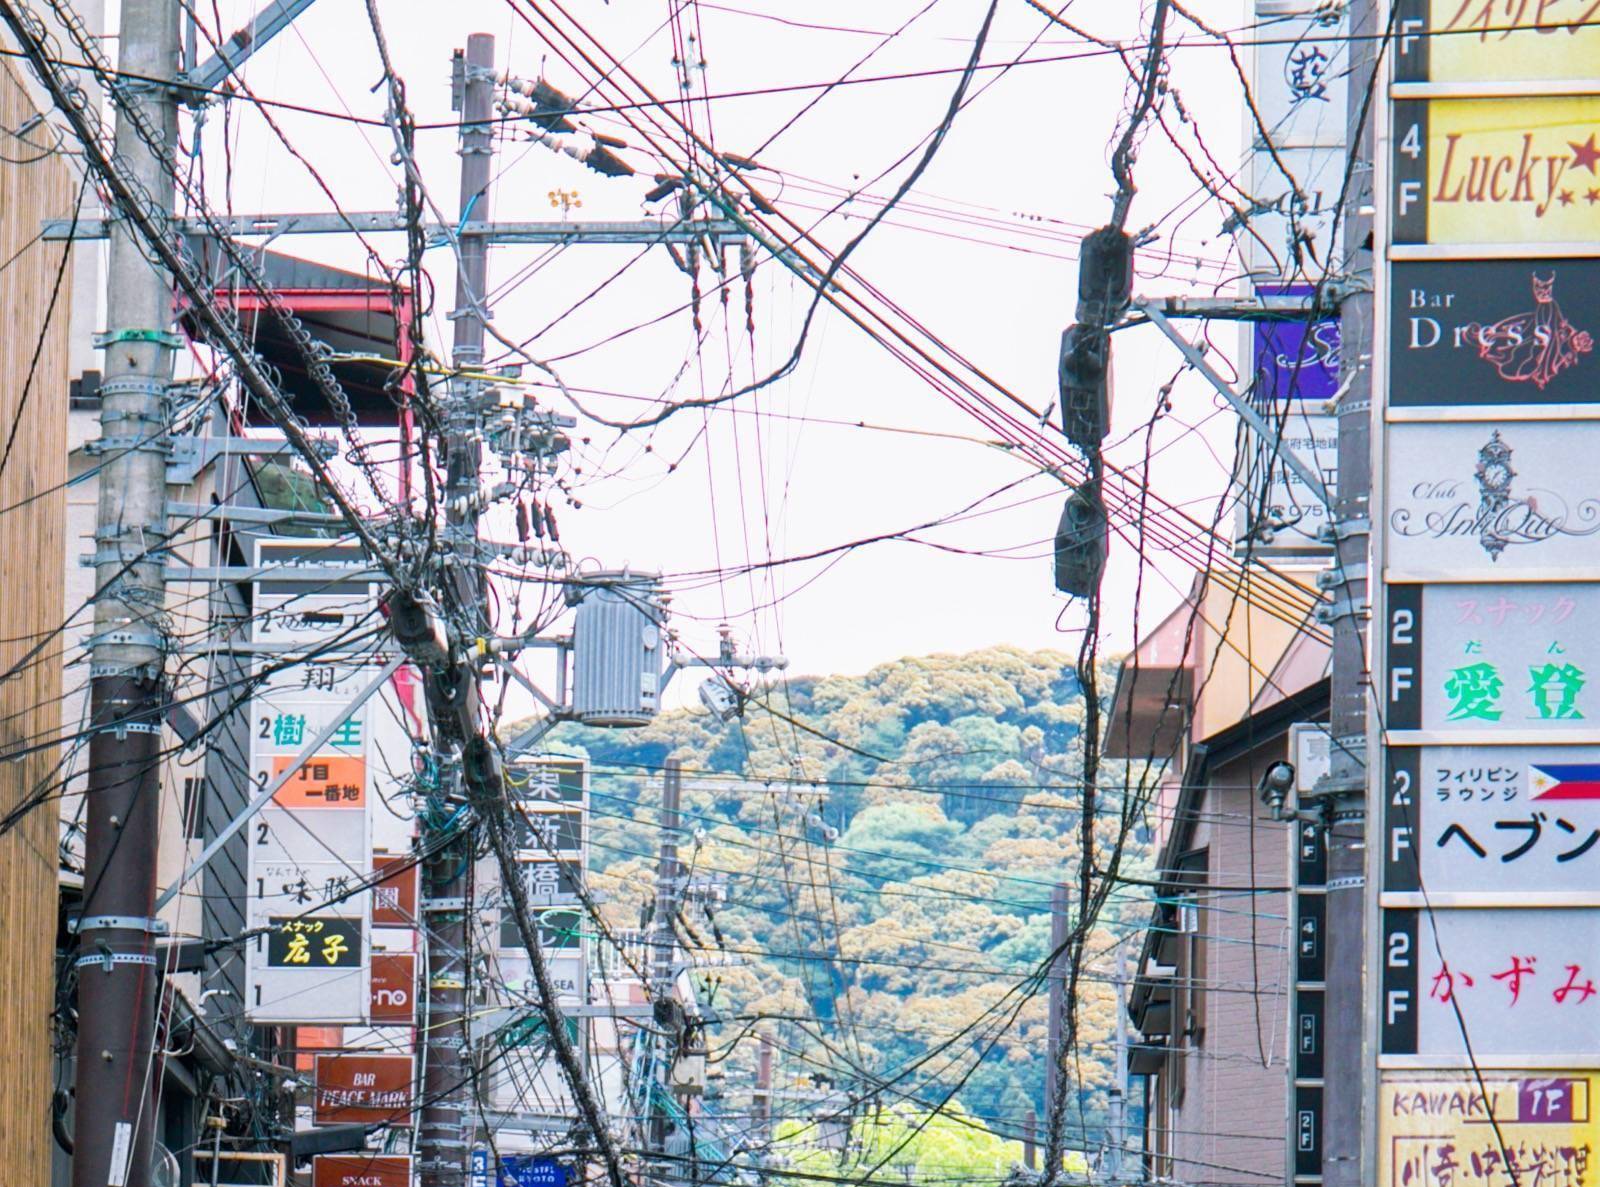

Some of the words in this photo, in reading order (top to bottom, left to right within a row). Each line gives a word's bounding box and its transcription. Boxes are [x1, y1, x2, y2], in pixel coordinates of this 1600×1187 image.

[1436, 131, 1569, 219] Lucky
[1408, 288, 1456, 308] Bar
[1408, 316, 1555, 349] Dress
[1455, 597, 1576, 627] スナック
[1391, 608, 1414, 702] 2F
[301, 666, 335, 692] 翔
[1443, 661, 1586, 722] 愛登
[259, 717, 272, 739] 2
[258, 771, 269, 792] 2
[1436, 767, 1520, 783] フィリピン
[305, 784, 360, 801] 一番地
[1436, 788, 1519, 802] ラウンジ
[256, 823, 269, 845] 2
[1436, 812, 1600, 864] ヘブン
[257, 878, 264, 899] 1
[283, 933, 348, 964] 広子
[1387, 931, 1410, 1026] 2F
[1430, 955, 1598, 1008] かずみ
[254, 984, 262, 1006] 1
[353, 1073, 376, 1087] BAR
[1392, 1089, 1499, 1119] KAWAKI
[342, 1176, 382, 1186] SNACK
